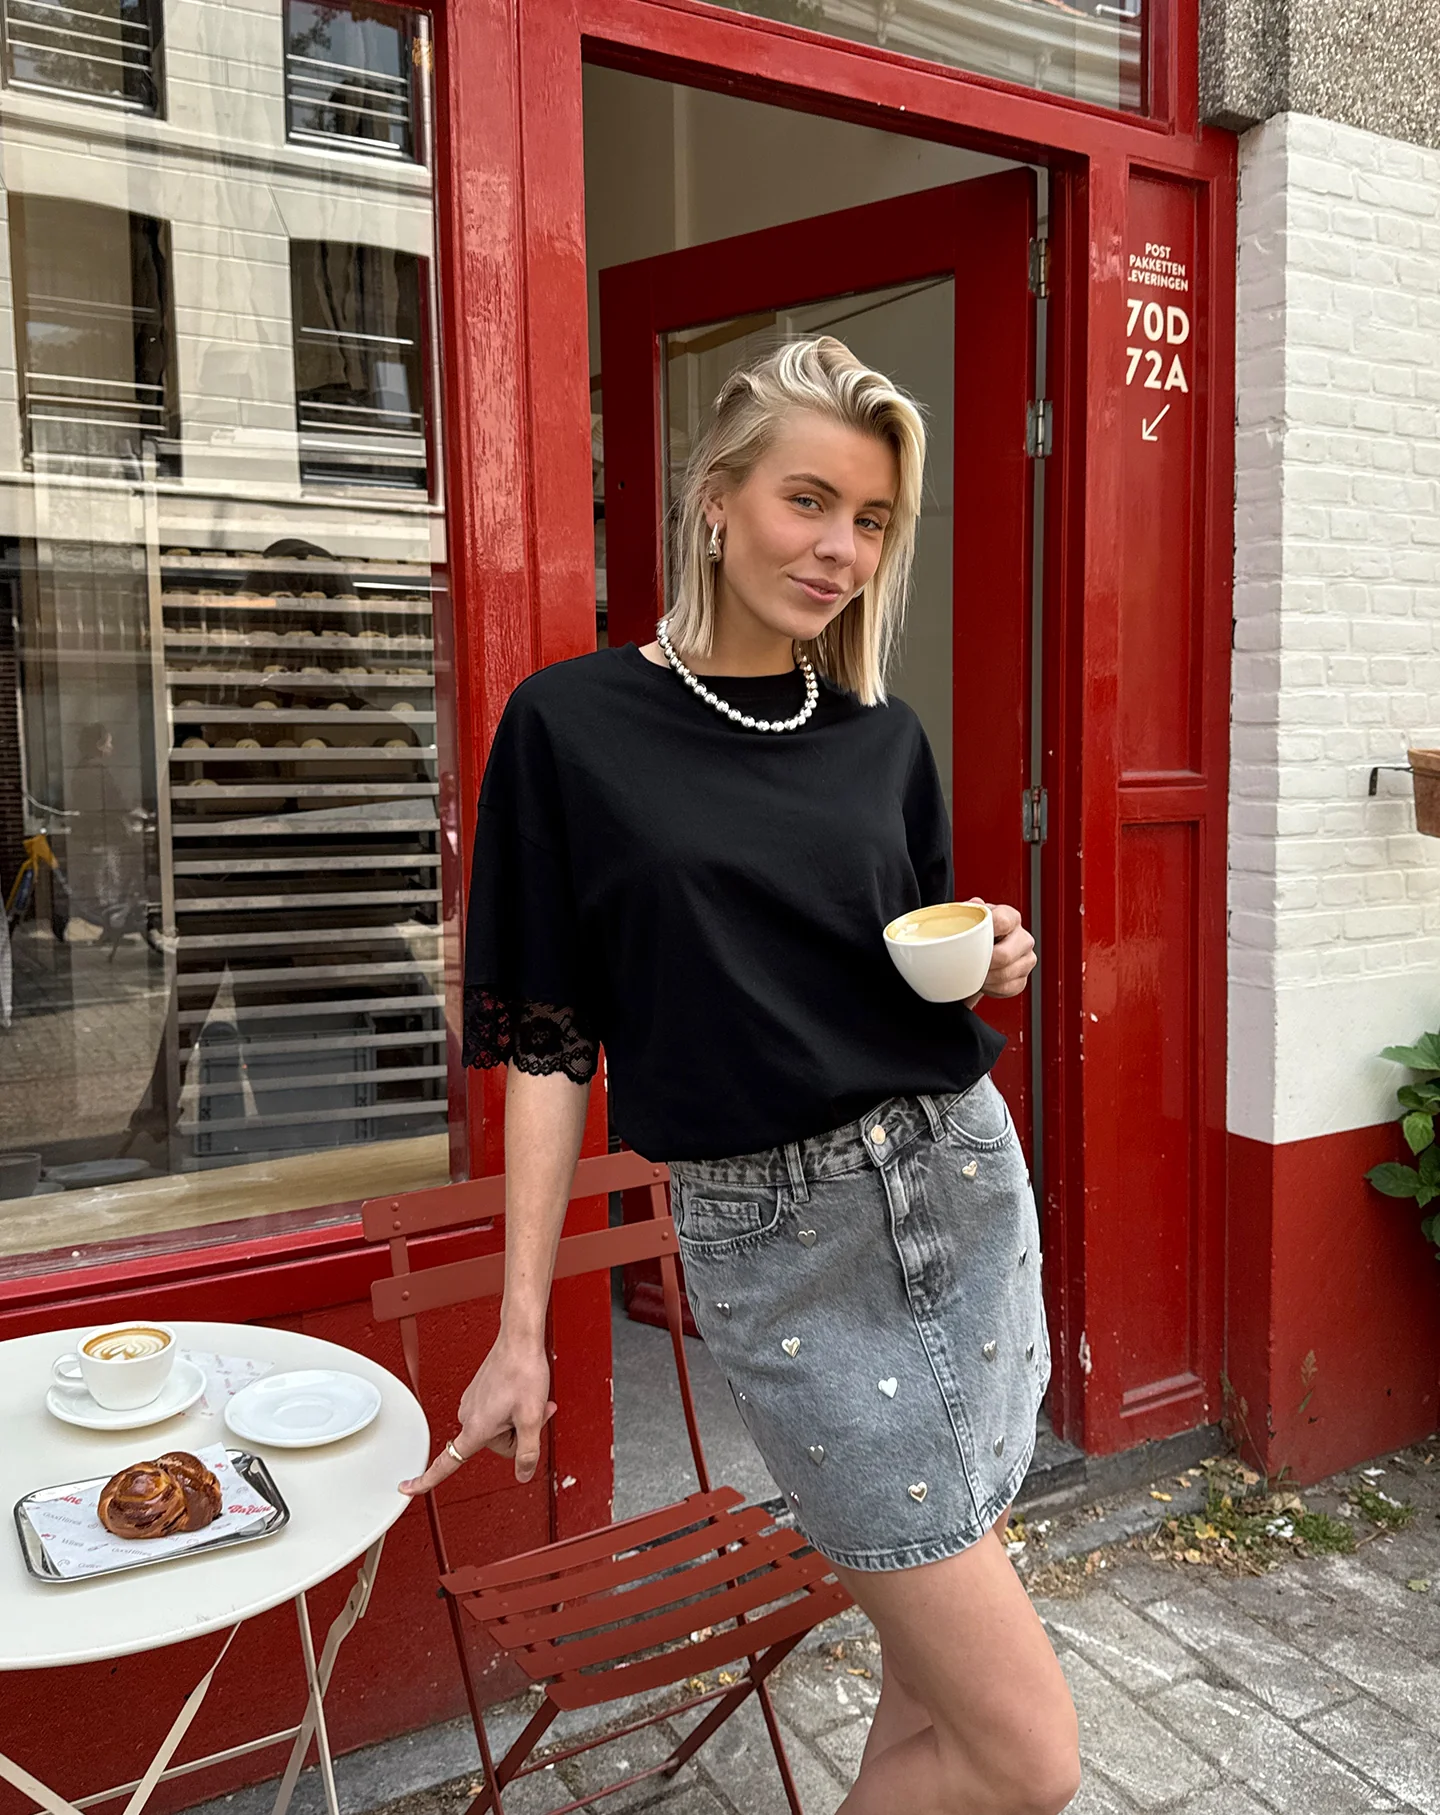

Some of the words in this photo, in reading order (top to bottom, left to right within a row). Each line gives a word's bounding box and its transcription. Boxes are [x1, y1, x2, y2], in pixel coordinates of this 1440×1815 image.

[1129, 254, 1186, 277] PAKKETTEN
[1145, 242, 1171, 259] POST
[1126, 298, 1190, 345] 70D
[1125, 346, 1189, 394] 72A
